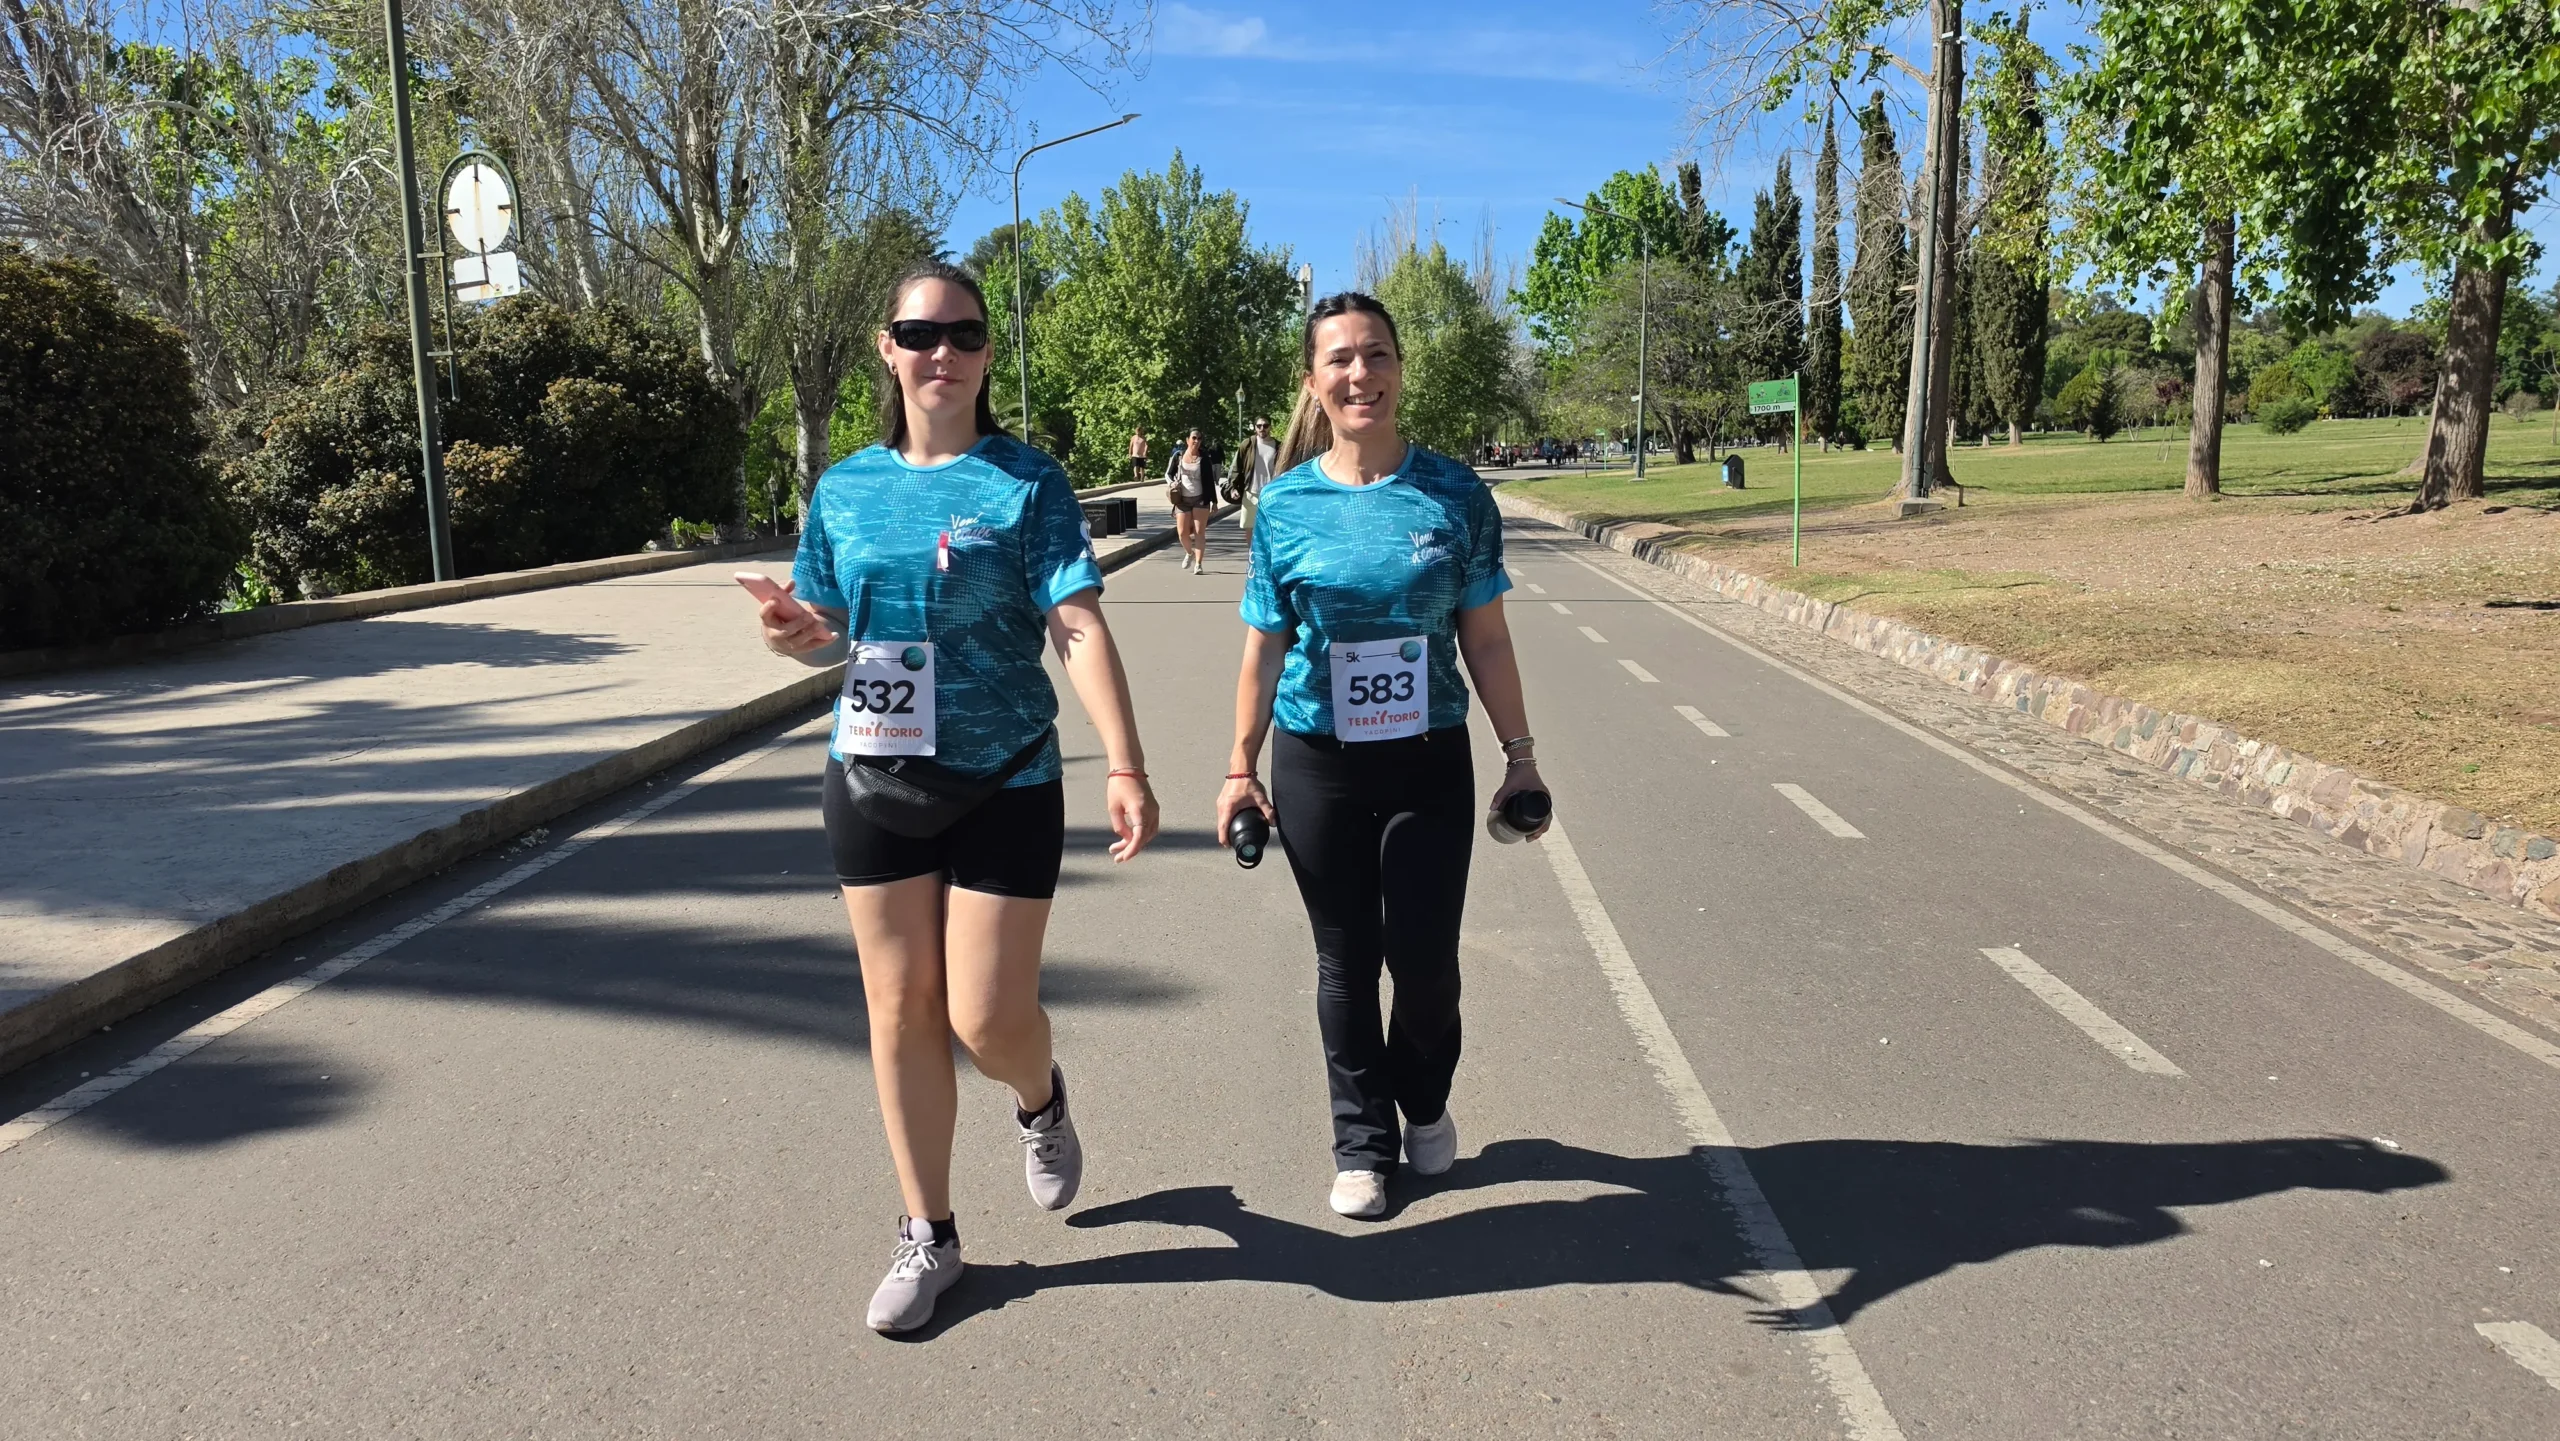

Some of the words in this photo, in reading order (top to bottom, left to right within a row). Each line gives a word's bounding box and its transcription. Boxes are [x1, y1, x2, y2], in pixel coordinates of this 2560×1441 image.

[1346, 652, 1360, 662] 5k
[1348, 671, 1414, 705] 583
[851, 679, 915, 714] 532
[1348, 710, 1420, 726] TERRITORIO
[849, 721, 923, 737] TERRITORIO
